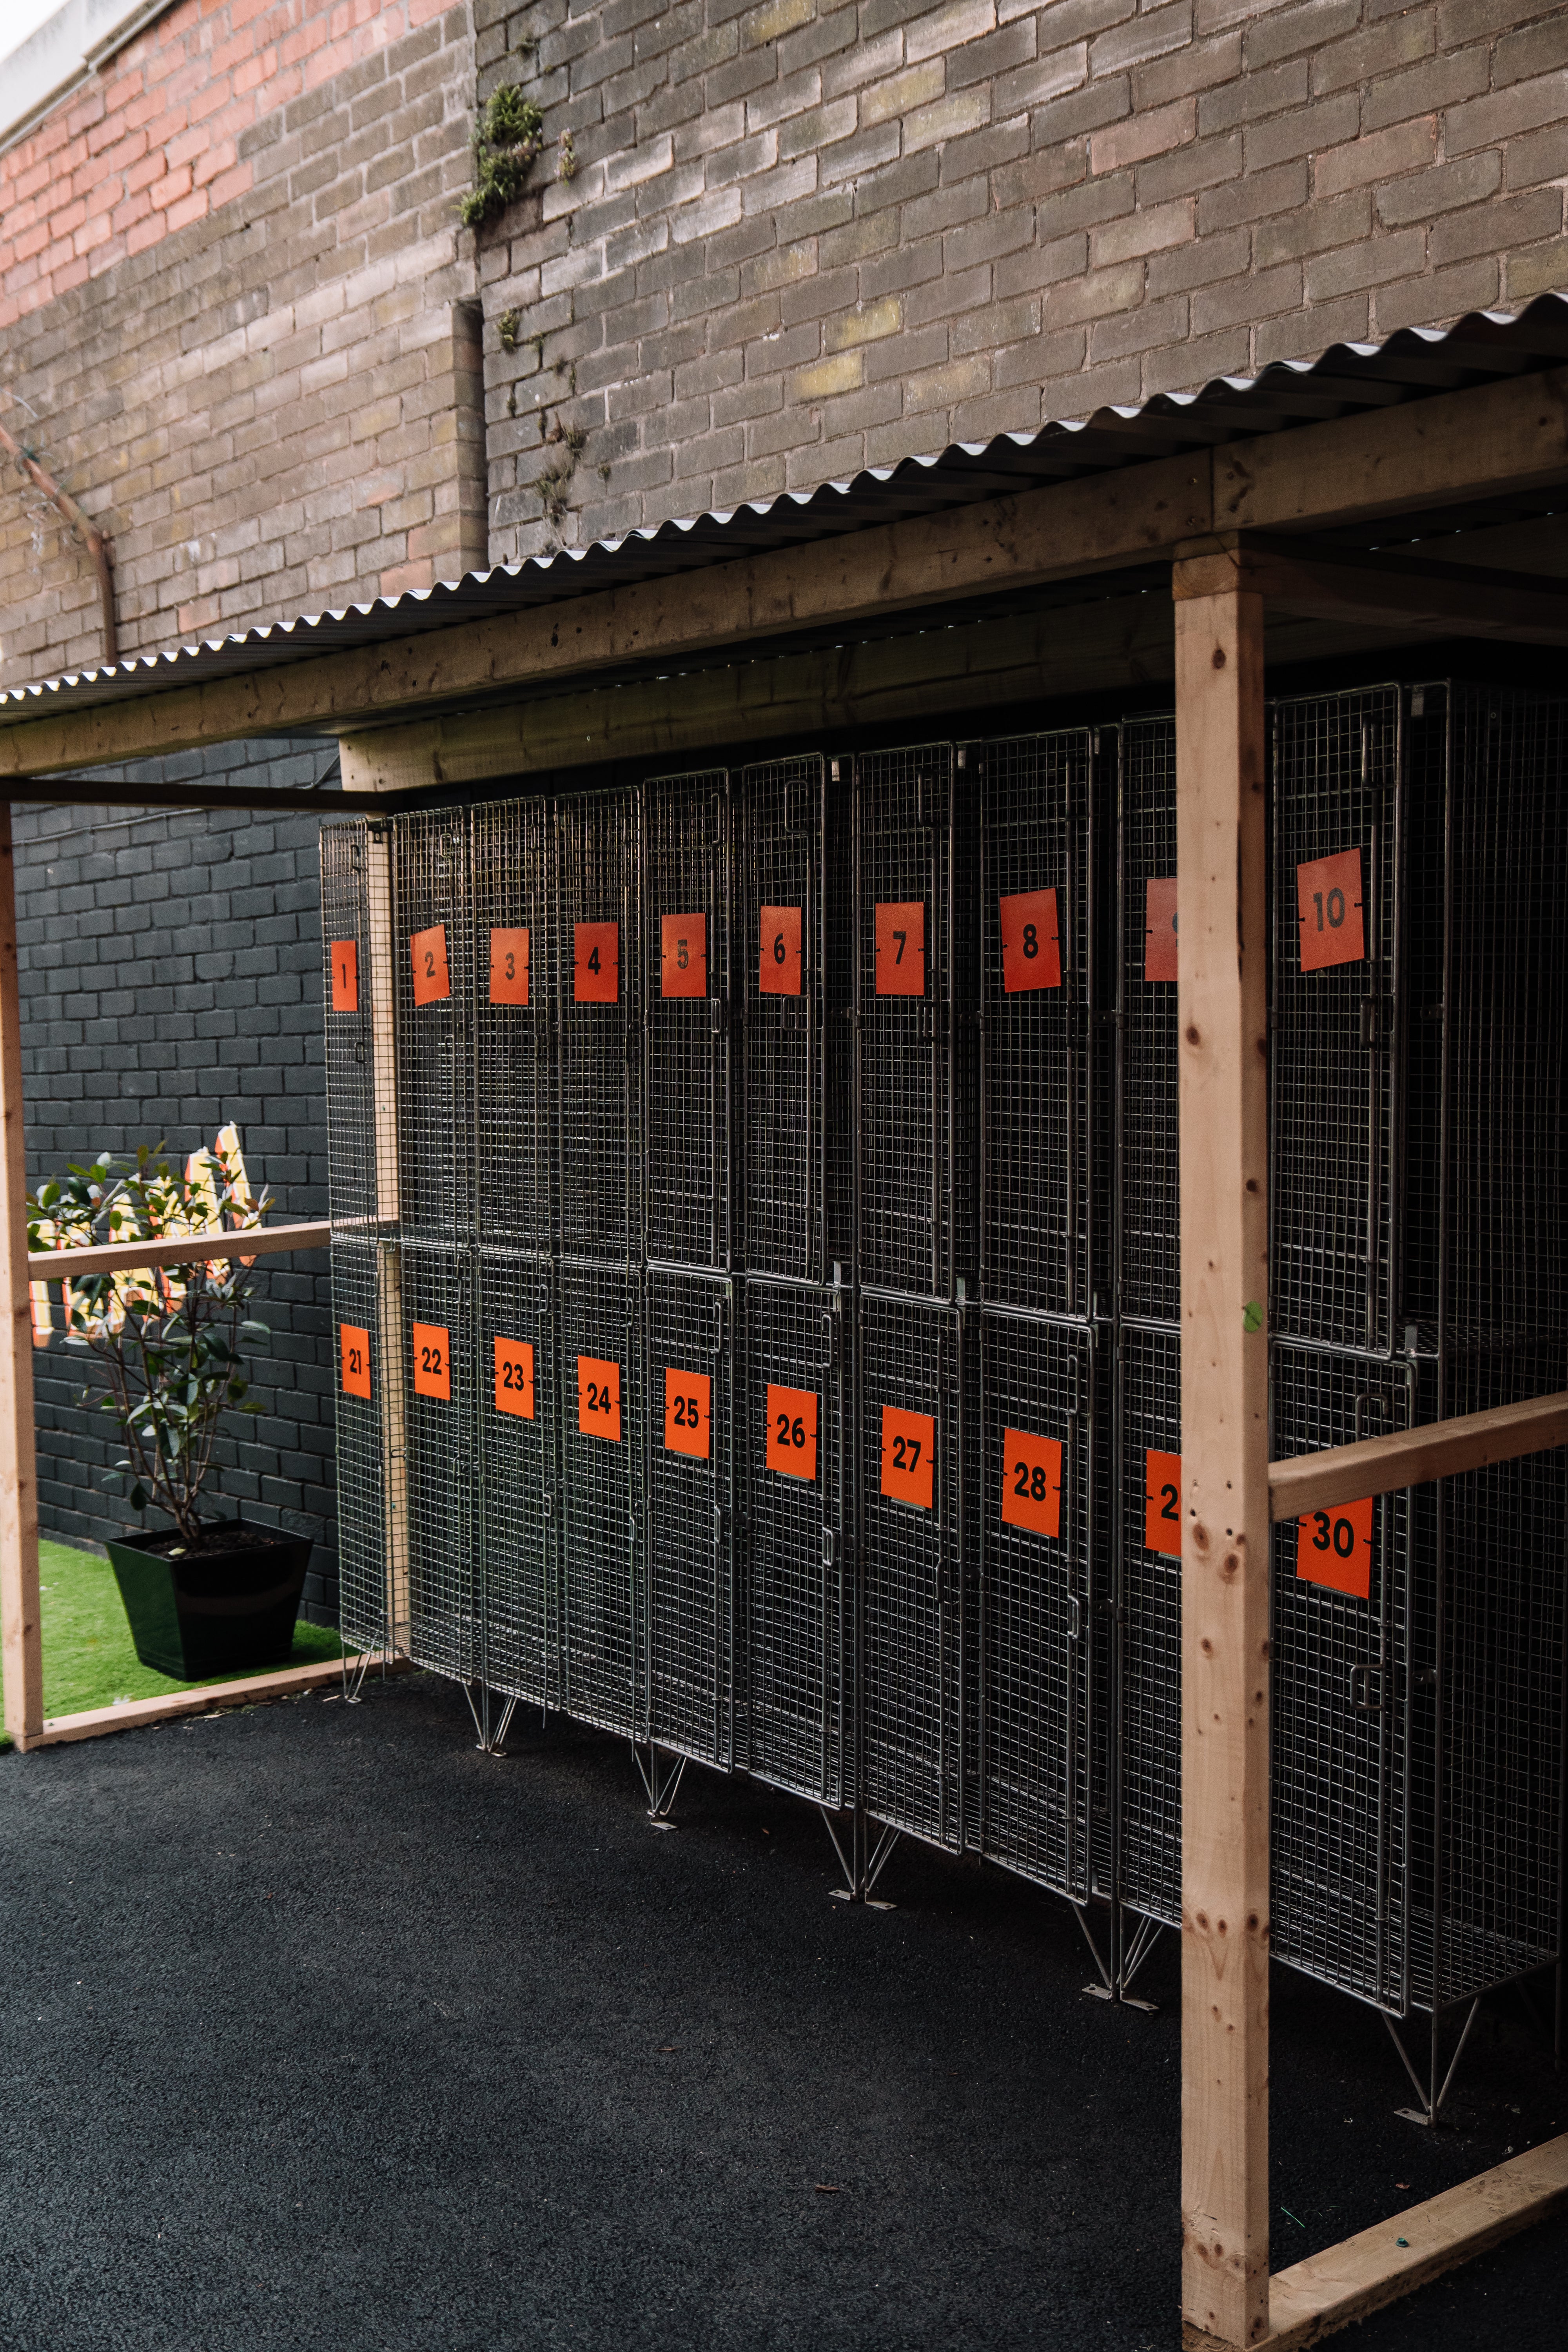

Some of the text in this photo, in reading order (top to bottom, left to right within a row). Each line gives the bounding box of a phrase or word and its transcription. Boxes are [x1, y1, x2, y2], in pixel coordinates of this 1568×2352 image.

[1313, 888, 1345, 931] 10
[677, 939, 689, 969] 5
[774, 933, 786, 964] 6
[893, 931, 906, 964] 7
[1023, 924, 1038, 959] 8
[342, 964, 347, 988] 1
[425, 952, 435, 977] 2
[505, 952, 515, 980] 3
[588, 947, 601, 975] 4
[349, 1348, 361, 1374] 21
[422, 1347, 442, 1375] 22
[503, 1362, 524, 1391] 23
[587, 1383, 611, 1414] 24
[674, 1396, 699, 1428] 25
[777, 1414, 806, 1448] 26
[893, 1436, 921, 1472] 27
[1014, 1462, 1046, 1501] 28
[1161, 1484, 1179, 1521] 2
[1312, 1511, 1354, 1558] 30
